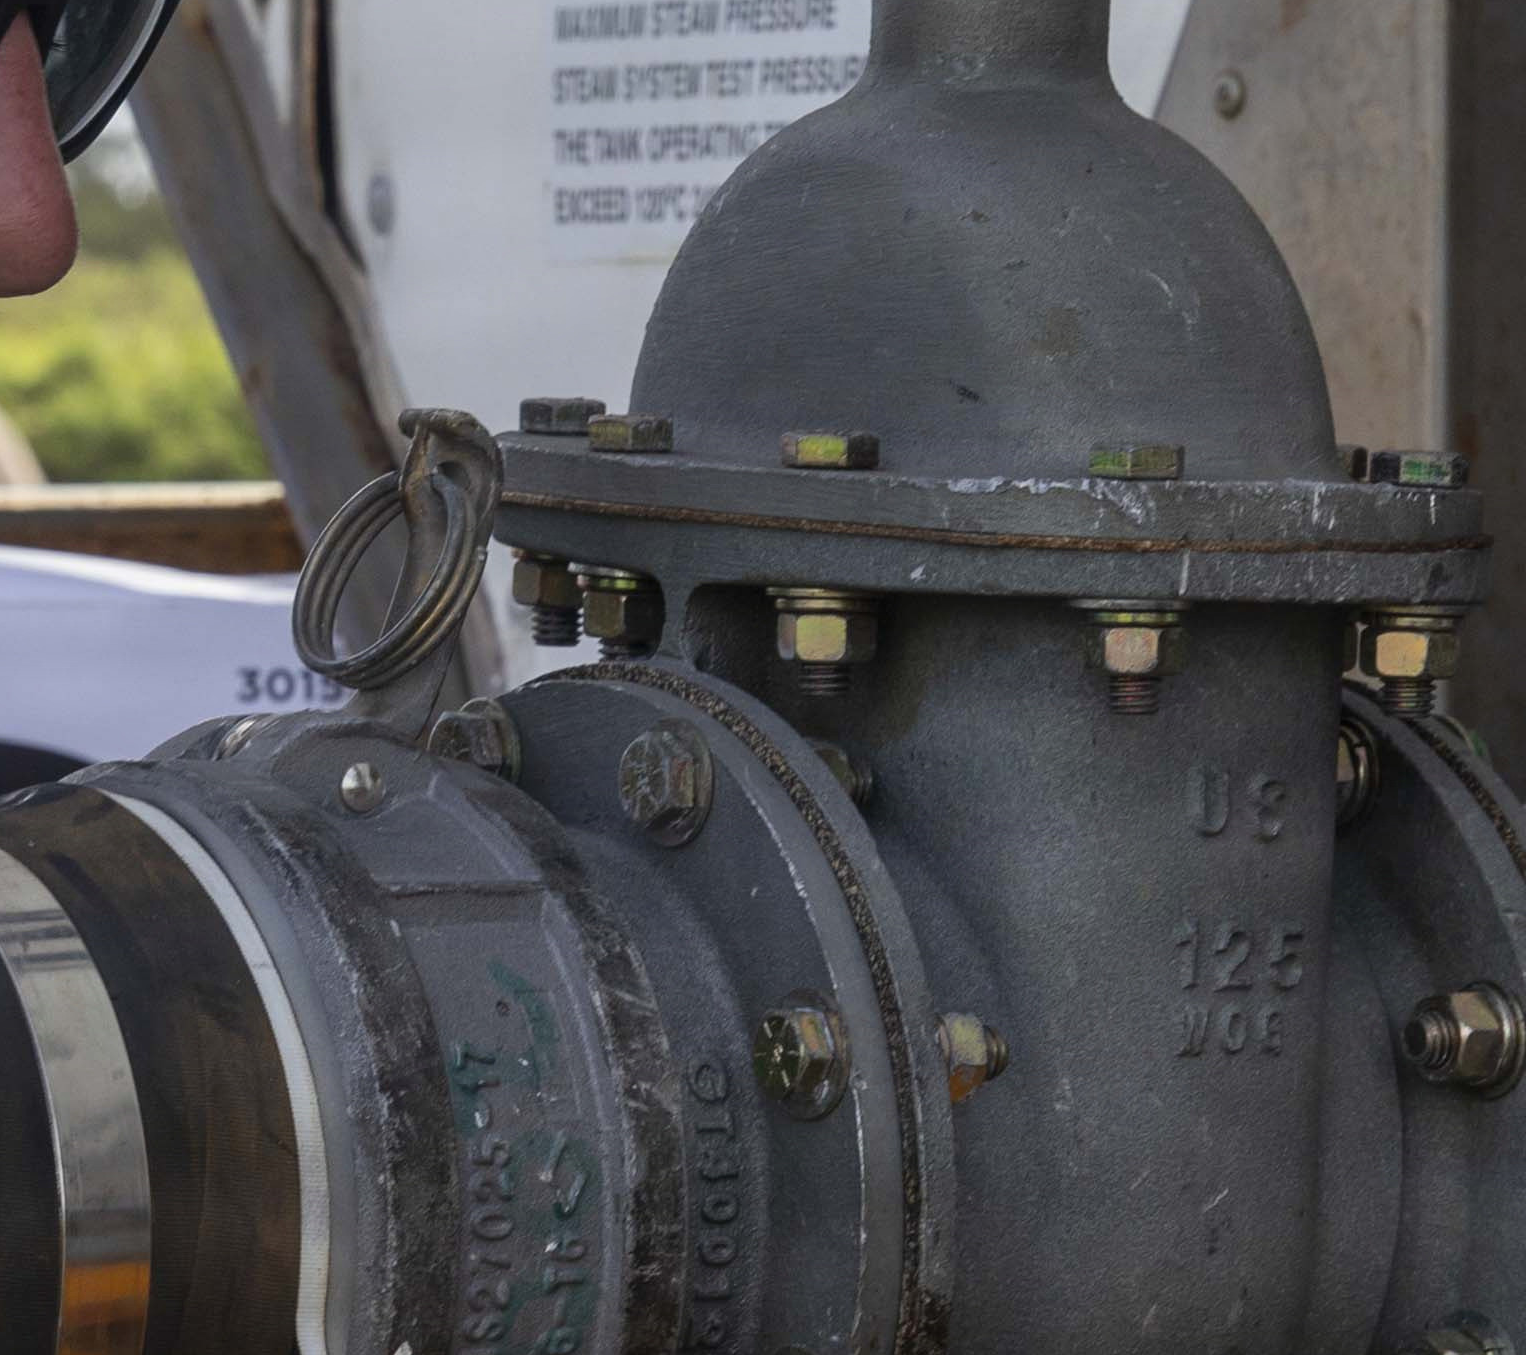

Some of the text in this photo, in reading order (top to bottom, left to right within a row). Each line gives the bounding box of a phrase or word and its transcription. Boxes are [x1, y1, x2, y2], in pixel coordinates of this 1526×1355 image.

[555, 2, 647, 43] MAXIMUM
[652, 0, 721, 38] STEAM
[554, 53, 868, 105] STEAM SYSTEM TEST PRESSUR
[553, 127, 589, 166] THE
[593, 126, 642, 163] TANK
[554, 187, 630, 226] EXCEED
[1174, 919, 1305, 992] 125
